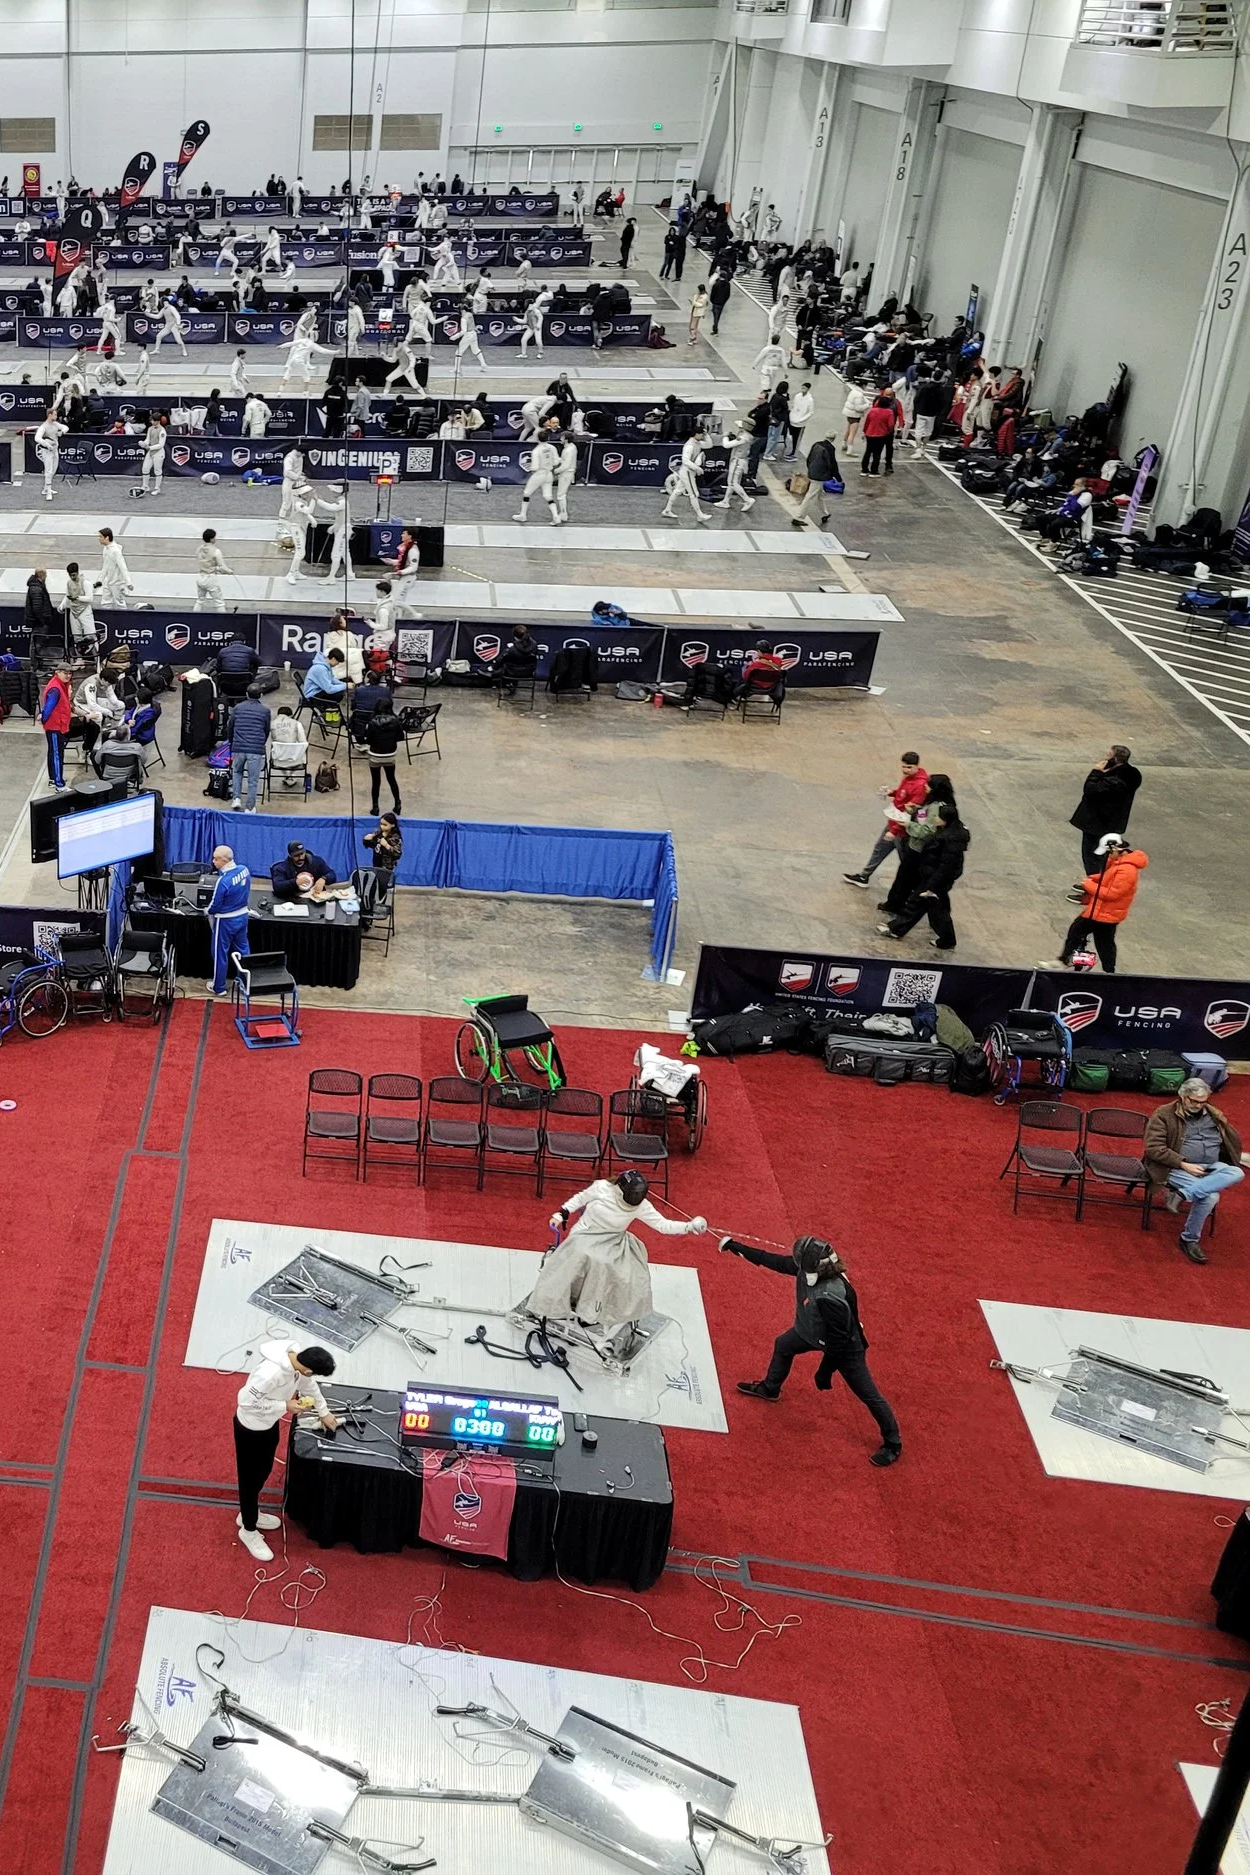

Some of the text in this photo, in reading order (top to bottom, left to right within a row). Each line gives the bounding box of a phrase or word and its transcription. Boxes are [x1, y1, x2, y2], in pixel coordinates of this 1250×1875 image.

[196, 122, 206, 135] S
[814, 107, 829, 148] A13
[139, 154, 150, 170] R
[896, 132, 912, 181] A18
[80, 210, 92, 228] Q
[1218, 232, 1247, 310] A23
[194, 451, 222, 459] USA
[254, 452, 284, 460] USA
[480, 455, 510, 463] USA
[382, 459, 391, 473] P
[628, 458, 659, 467] USA
[8, 624, 32, 633] US
[115, 629, 153, 638] USA
[598, 646, 640, 656] USA
[716, 649, 758, 658] USA
[809, 651, 852, 660] USA
[1114, 1006, 1182, 1020] USA
[1118, 1020, 1171, 1029] FENCING
[405, 1413, 430, 1428] 00
[528, 1426, 555, 1442] 00
[454, 1520, 478, 1528] USA
[153, 1658, 170, 1714] ABSOLUTE FENCING
[170, 1676, 197, 1703] AF
